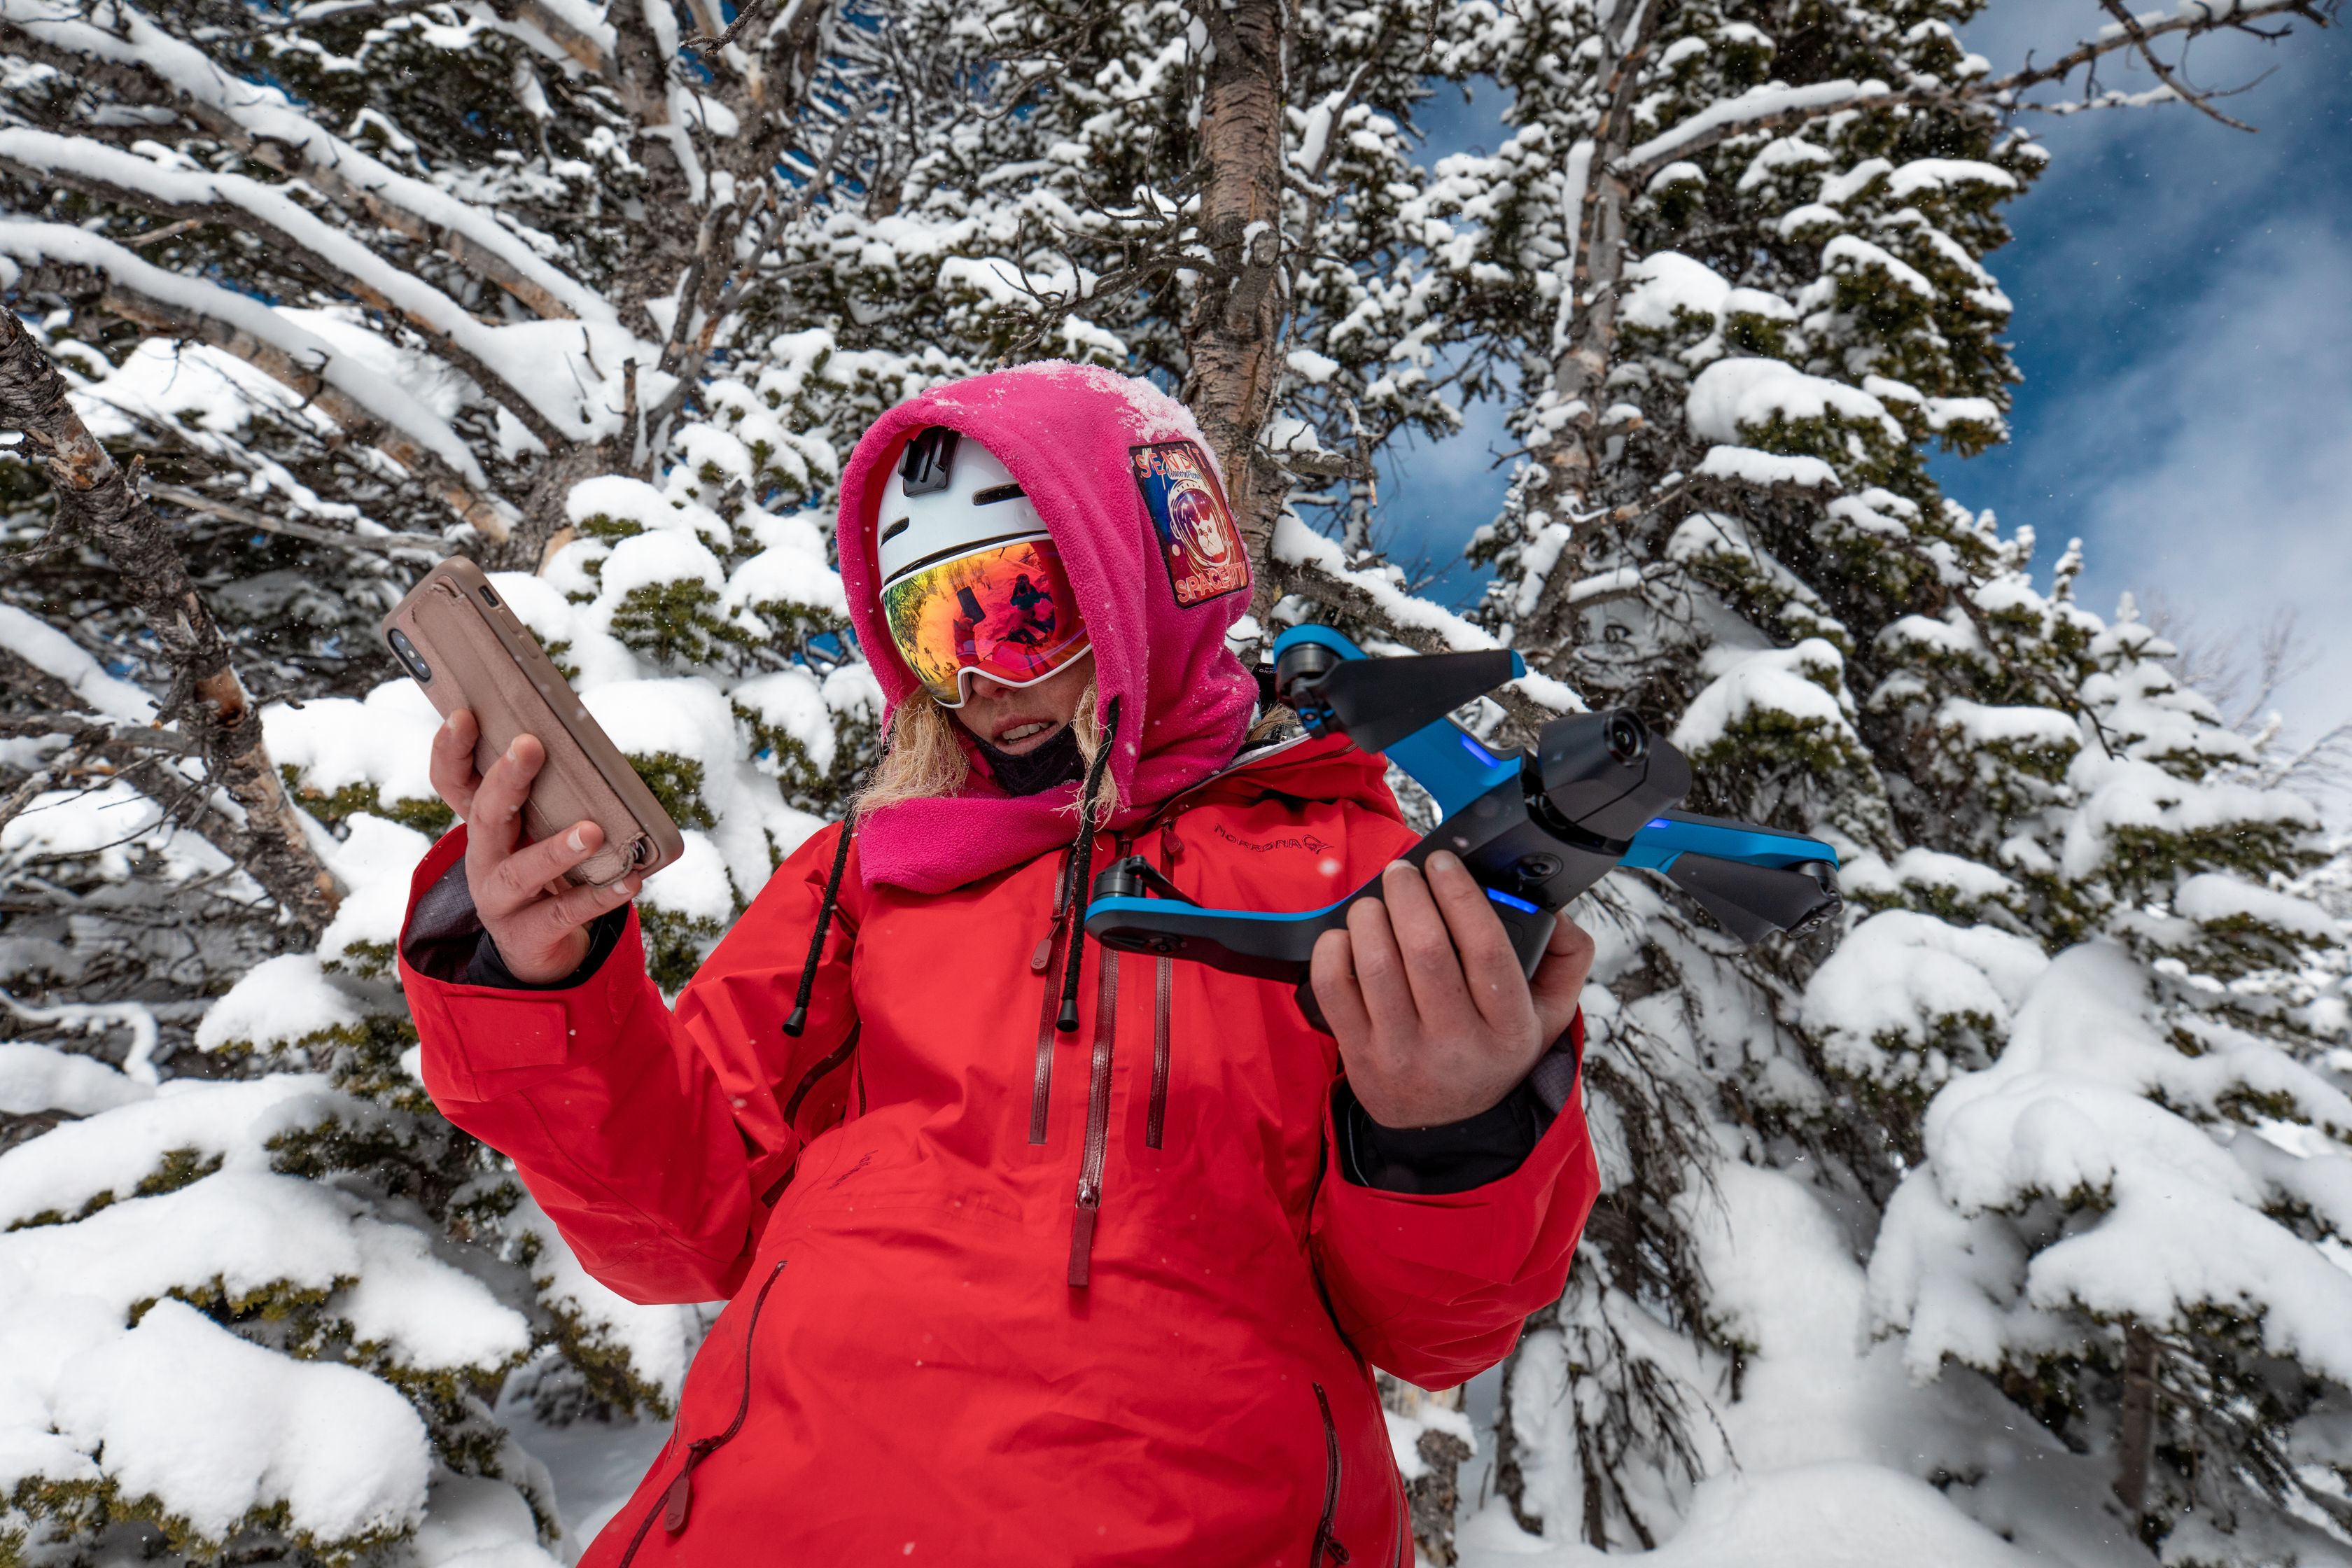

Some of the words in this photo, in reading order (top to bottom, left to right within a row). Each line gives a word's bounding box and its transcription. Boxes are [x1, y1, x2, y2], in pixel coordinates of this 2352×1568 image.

[1135, 449, 1191, 478] SEND
[1175, 566, 1230, 603] SPACE
[1213, 822, 1303, 853] NORRØNA
